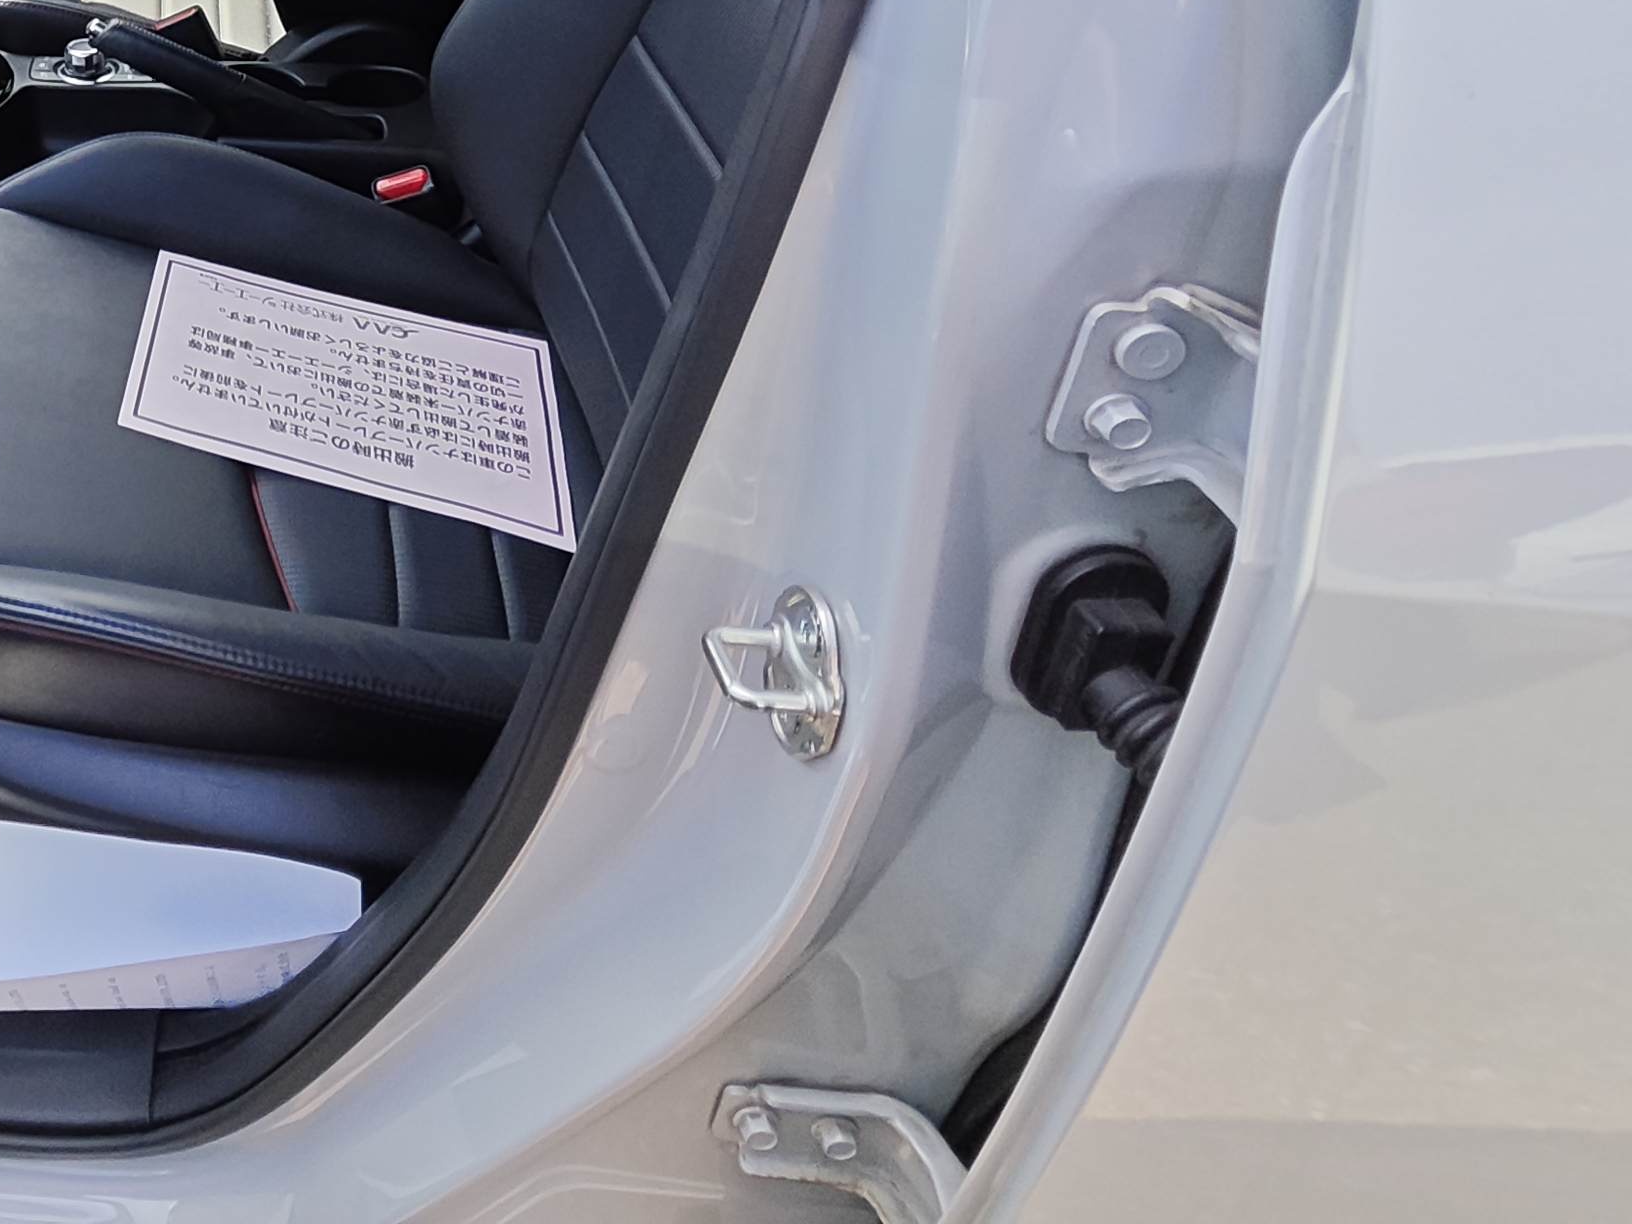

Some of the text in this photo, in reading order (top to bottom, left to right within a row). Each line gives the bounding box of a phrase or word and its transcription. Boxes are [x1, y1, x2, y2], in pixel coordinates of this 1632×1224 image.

[171, 375, 530, 479] この車はナンバープレートが付いていません。
[268, 417, 413, 469] 搬出時のご注意
